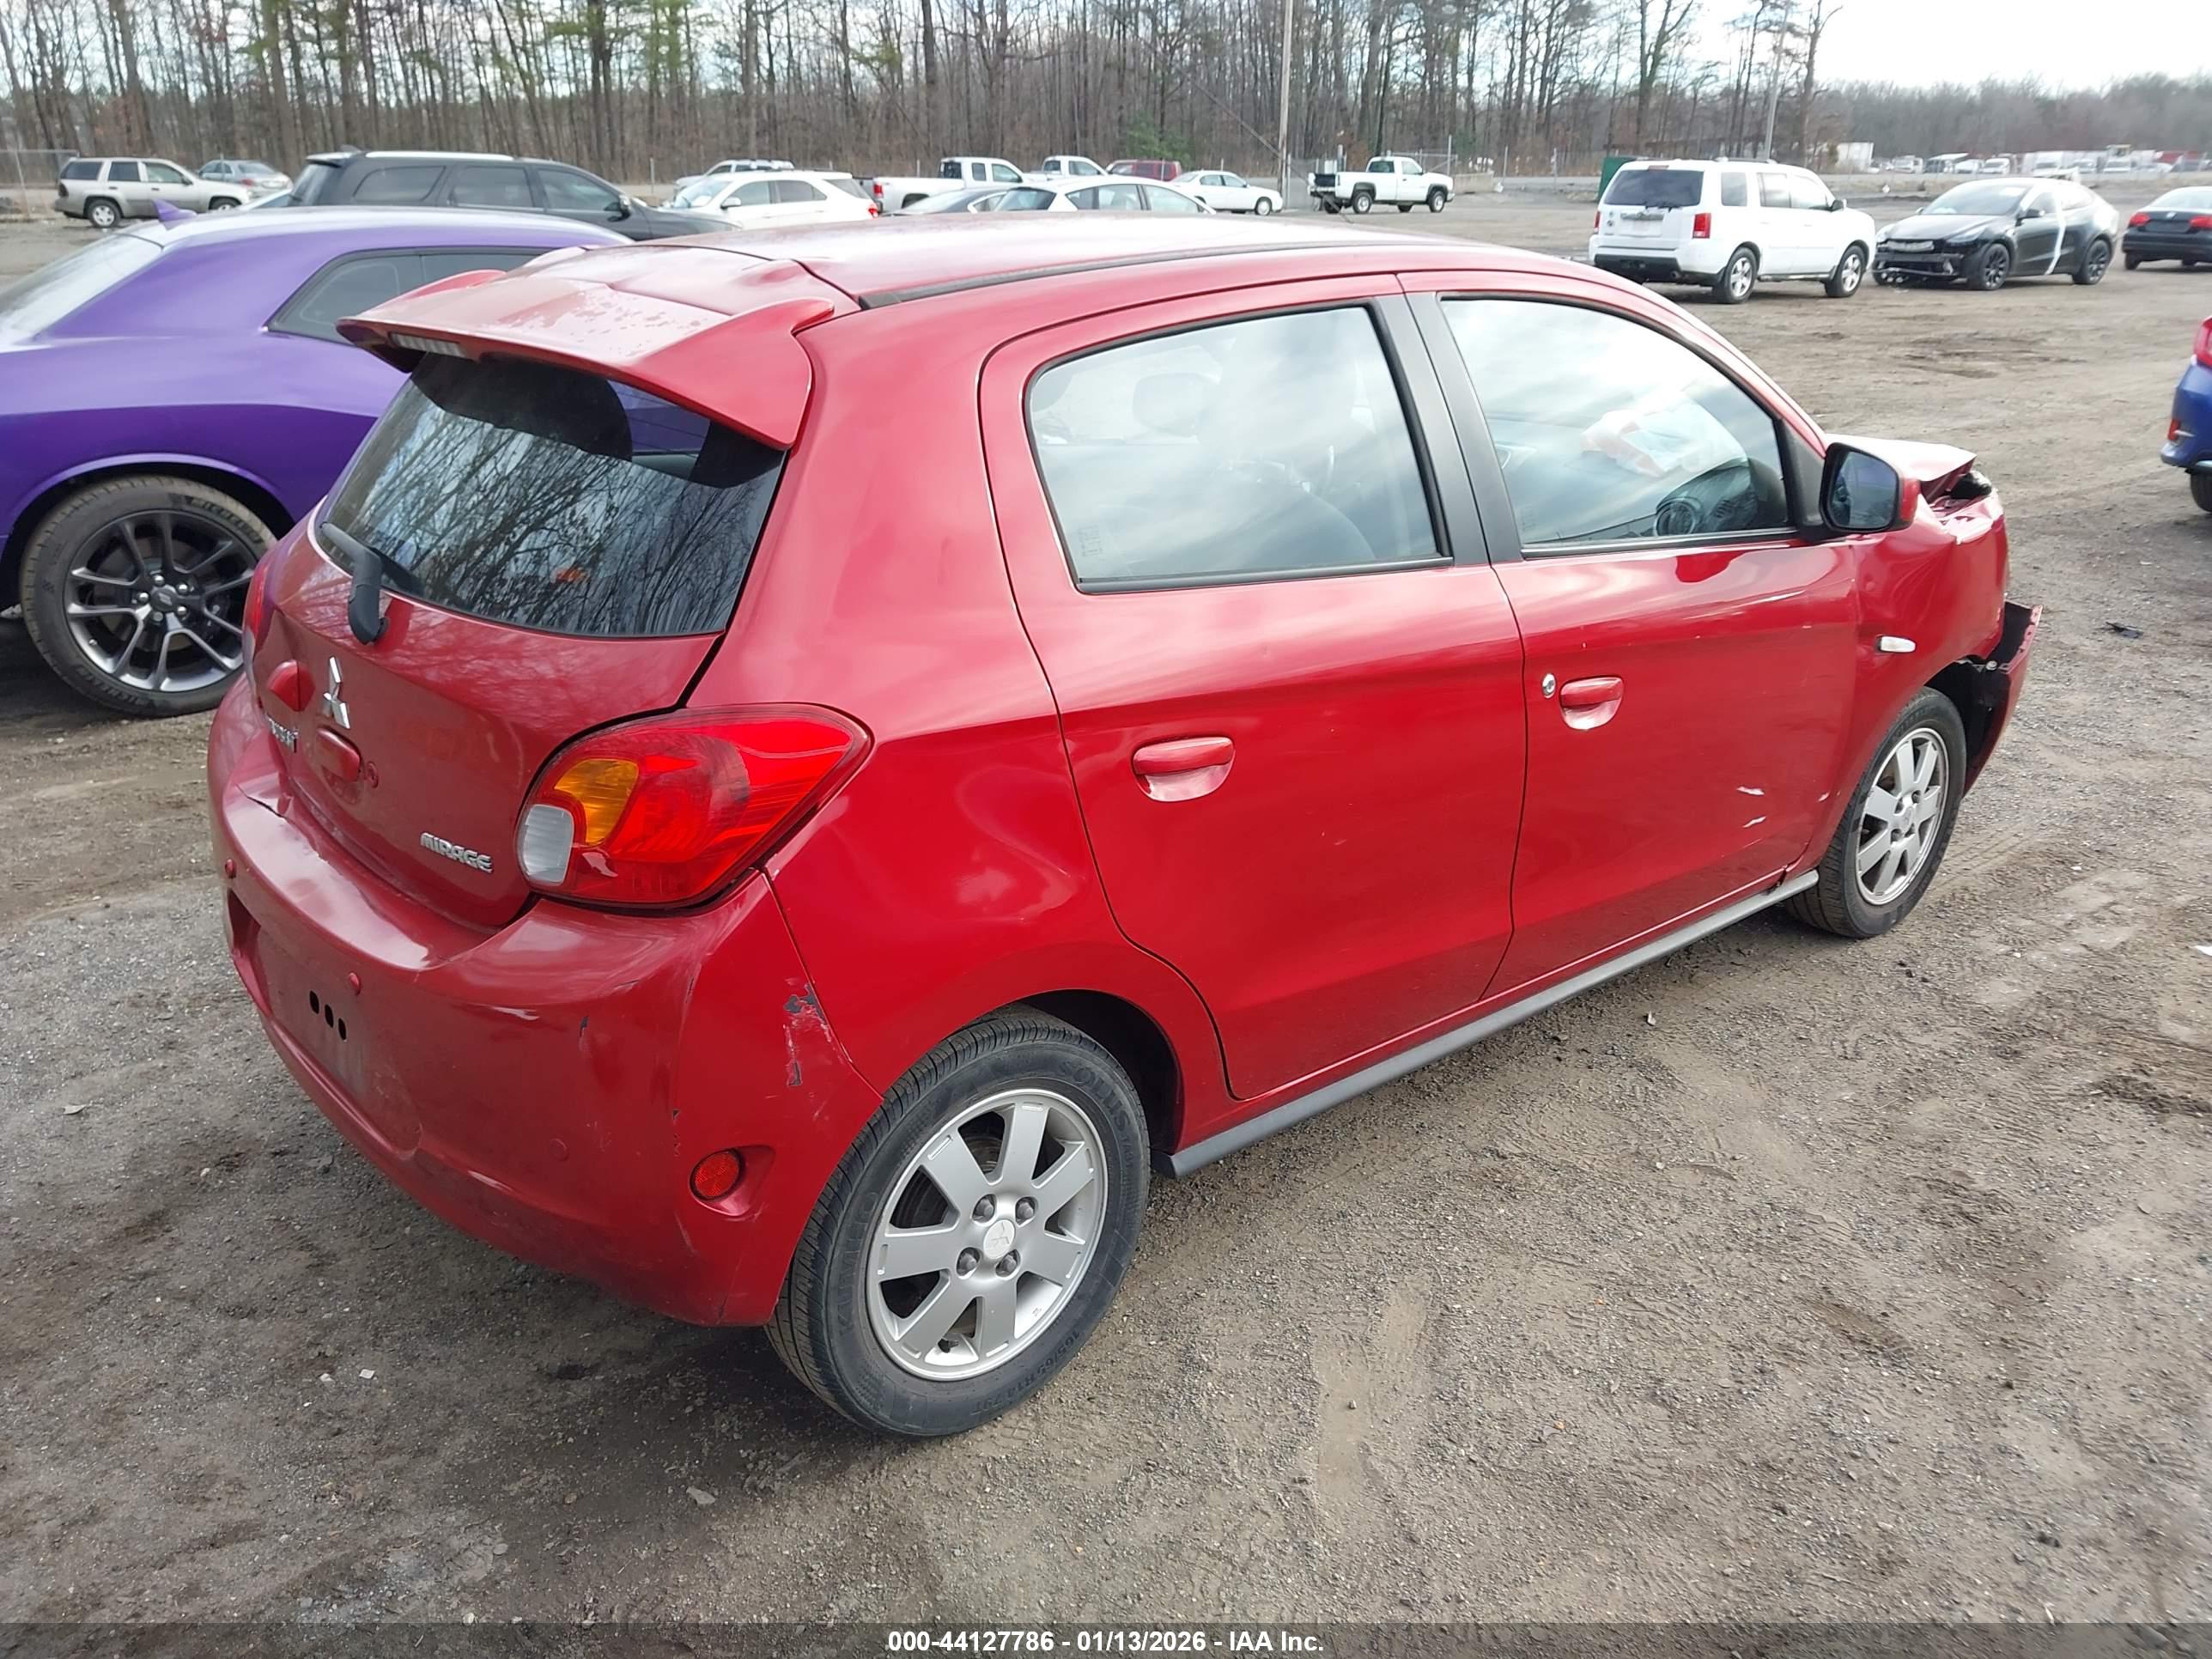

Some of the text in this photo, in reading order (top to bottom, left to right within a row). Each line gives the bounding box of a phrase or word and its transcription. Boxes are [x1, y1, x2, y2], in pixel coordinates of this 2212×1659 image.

[419, 831, 495, 873] MIRAGE
[1057, 1060, 1131, 1132] SOLUS
[837, 1191, 880, 1336] KUMHO
